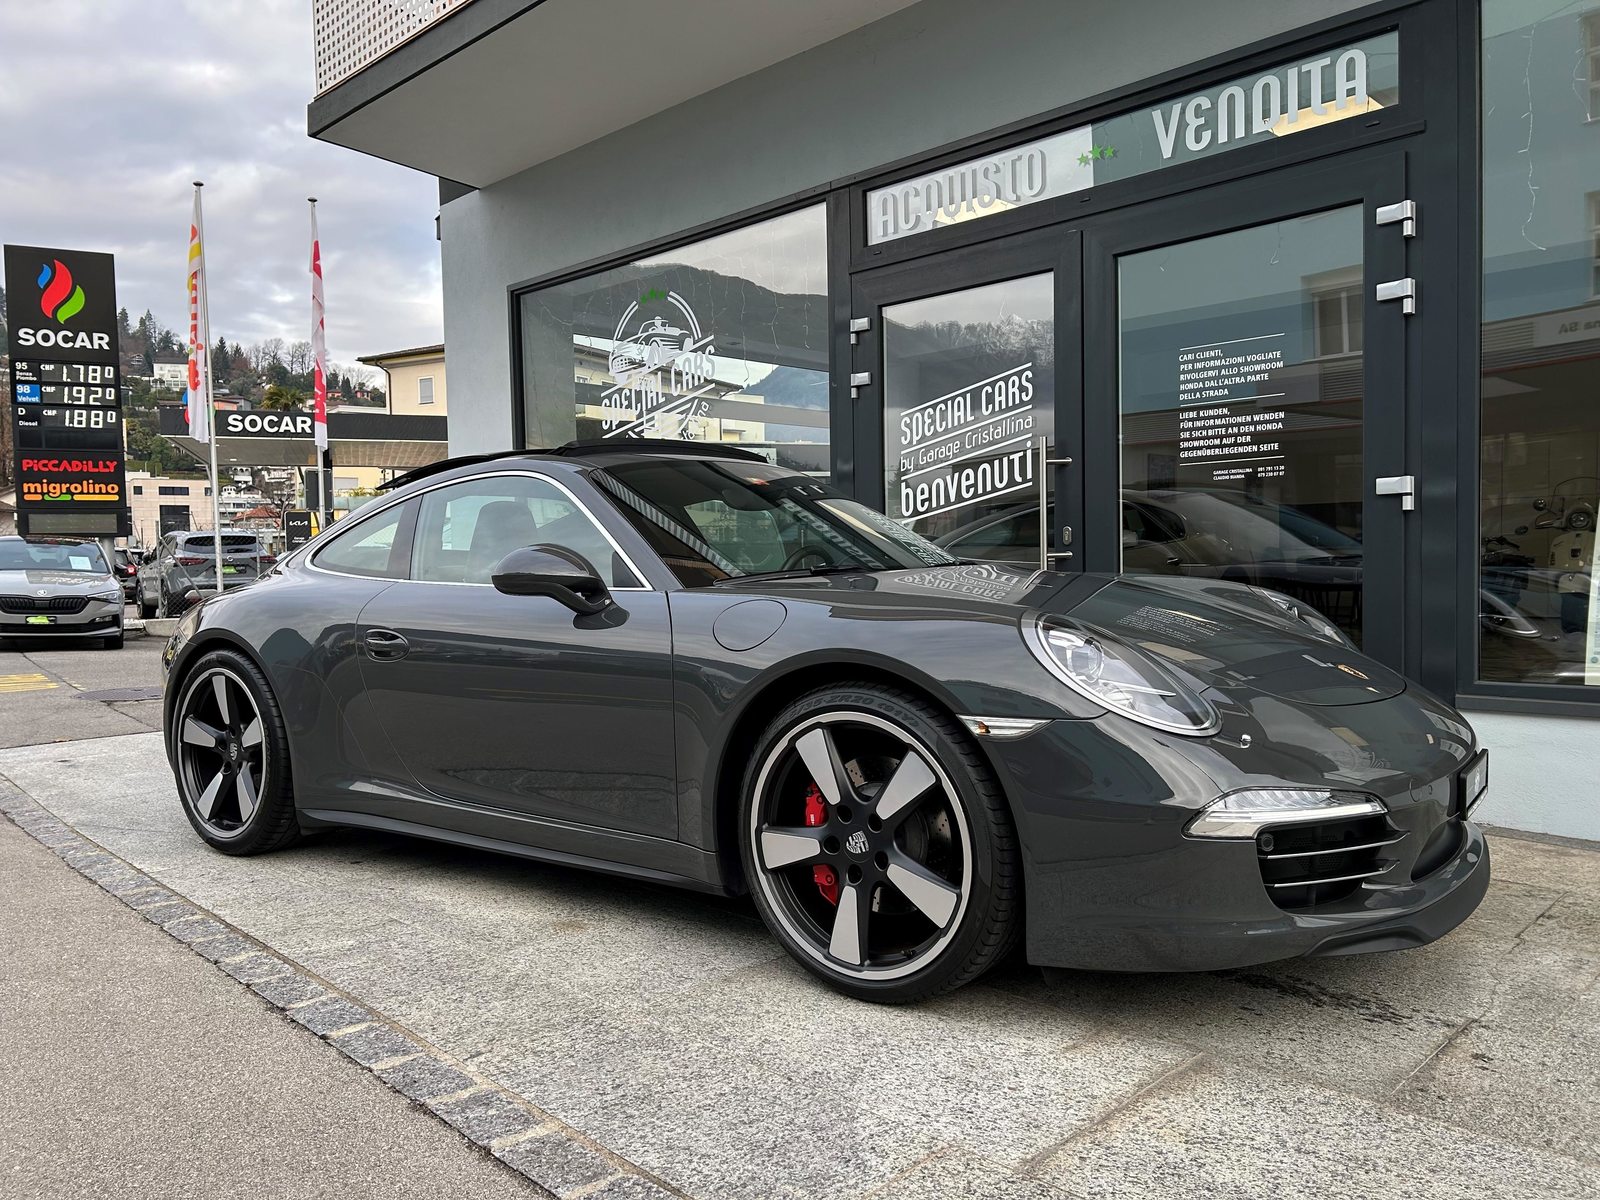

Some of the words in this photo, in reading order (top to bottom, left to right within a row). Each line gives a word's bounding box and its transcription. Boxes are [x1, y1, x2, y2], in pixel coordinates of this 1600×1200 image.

[1151, 47, 1369, 160] VENDITA
[876, 148, 1047, 238] ACQUISTO
[17, 327, 111, 351] SOCAR
[1179, 353, 1195, 362] CARI
[1195, 349, 1224, 359] CLIENTI,
[1180, 363, 1193, 372] PER
[1194, 355, 1245, 370] INFORMAZIONI
[1246, 350, 1282, 362] VOGLIATE
[15, 361, 28, 370] 95
[670, 345, 716, 397] CARS
[1180, 369, 1219, 381] RIVOLGERVI
[1220, 366, 1238, 376] ALLO
[1240, 360, 1284, 373] SHOWROOM
[16, 385, 31, 394] 98
[1180, 380, 1204, 391] HONDA
[1204, 376, 1246, 388] DALL'ALTRA
[1246, 372, 1269, 383] PARTE
[17, 395, 40, 403] Velvet
[1180, 391, 1201, 401] DELLA
[1201, 388, 1229, 398] STRADA
[17, 407, 26, 416] D
[900, 392, 976, 446] SPECIAL
[981, 370, 1034, 417] CARS
[1180, 410, 1198, 420] LIEBE
[1199, 407, 1230, 418] KUNDEN,
[226, 414, 313, 434] SOCAR
[1180, 420, 1193, 429] FÜR
[1193, 415, 1252, 428] INFORMATIONEN
[1252, 411, 1285, 422] WENDEN
[1180, 431, 1191, 439] SIE
[1191, 429, 1207, 438] SICH
[1207, 427, 1226, 436] BITTE
[1227, 426, 1239, 434] AN
[1240, 424, 1255, 433] DEN
[1256, 421, 1283, 432] HONDA
[900, 455, 914, 473] by
[918, 439, 961, 465] Garage
[965, 415, 1034, 450] Cristallina
[1180, 438, 1221, 449] SHOWROOM
[1221, 436, 1236, 445] AUF
[1237, 435, 1252, 444] DER
[1180, 444, 1258, 458] GEGENÜBERLIEGENDEN
[1259, 442, 1280, 452] SEITE
[22, 479, 120, 498] migrolino
[900, 440, 1034, 518] benvenuti
